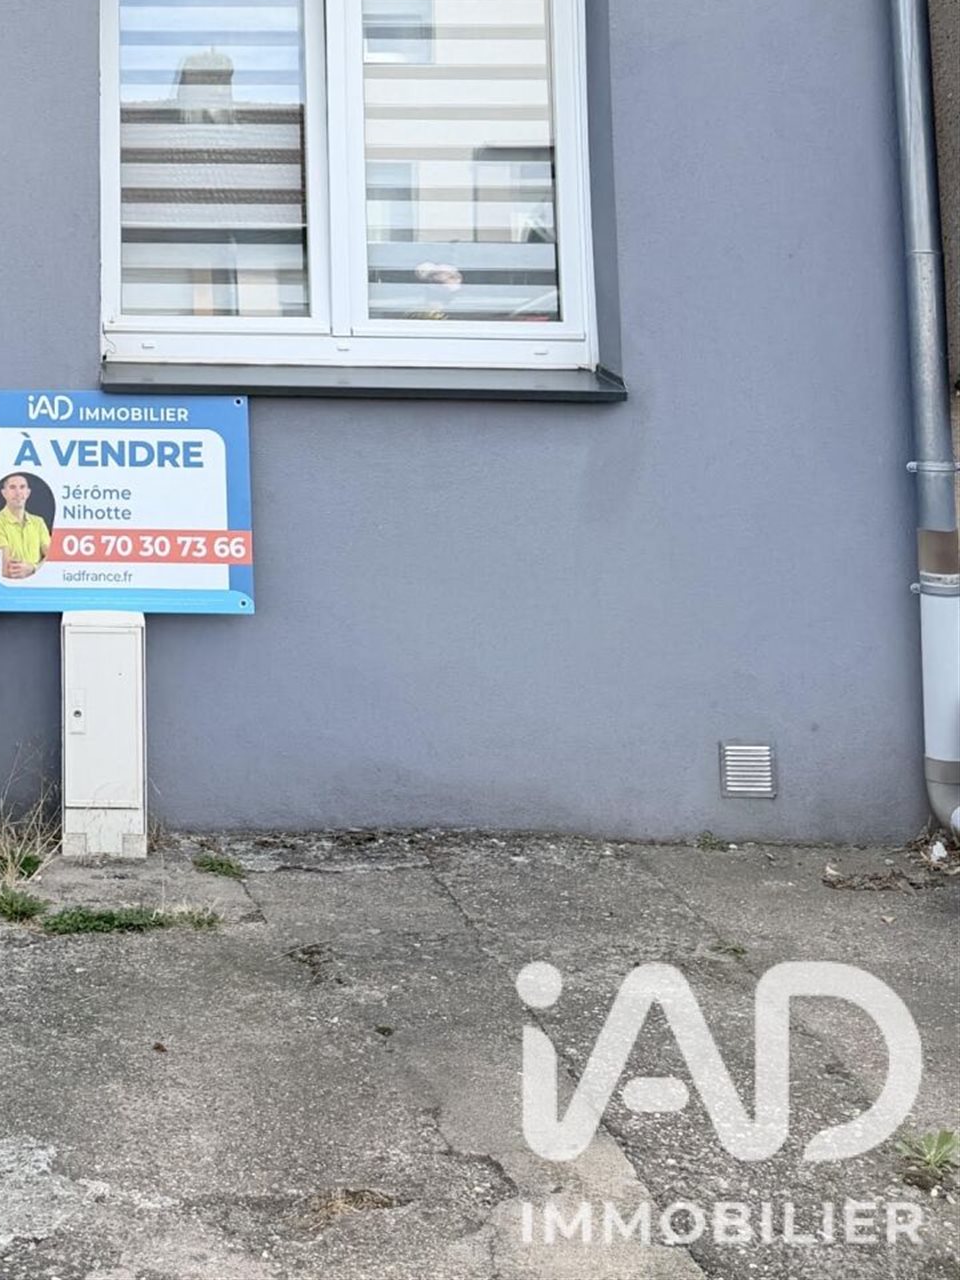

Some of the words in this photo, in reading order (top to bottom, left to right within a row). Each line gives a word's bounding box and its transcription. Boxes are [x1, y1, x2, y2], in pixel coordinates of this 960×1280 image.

[79, 407, 189, 422] IMMOBILIER
[13, 432, 42, 467] À
[50, 440, 204, 468] VENDRE
[62, 485, 132, 501] Jérôme
[62, 505, 132, 521] Nihotte
[62, 535, 96, 556] 06
[101, 535, 133, 557] 70
[139, 535, 171, 557] 30
[177, 536, 207, 558] 73
[213, 537, 246, 558] 66
[62, 570, 133, 584] iadfrance.fr
